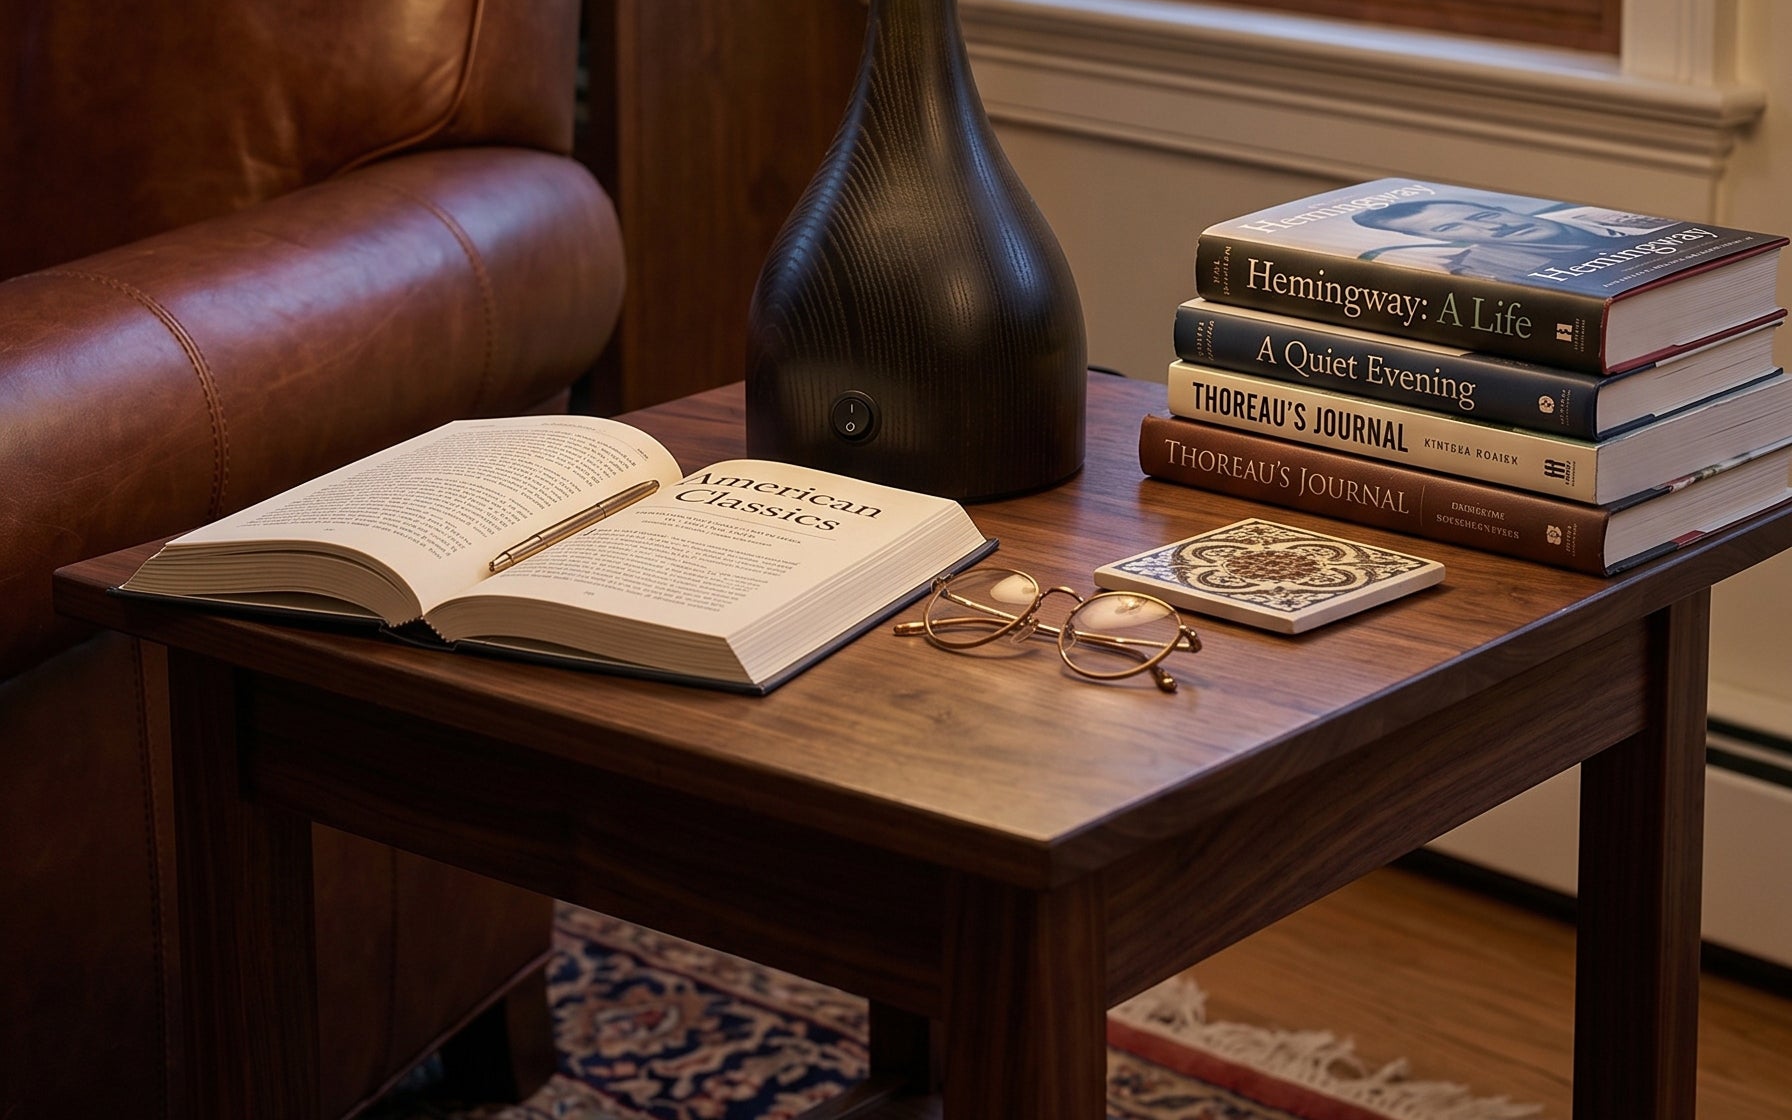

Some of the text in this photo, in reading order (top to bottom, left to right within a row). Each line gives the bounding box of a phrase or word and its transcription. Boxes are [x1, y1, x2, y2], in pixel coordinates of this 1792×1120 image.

[1242, 183, 1436, 234] Hemingway
[1527, 227, 1719, 283] Hemingway
[1246, 257, 1429, 327] Hemingway:
[1435, 292, 1463, 327] A
[1470, 296, 1533, 340] Life
[1255, 335, 1278, 365] A
[1284, 340, 1359, 379] Quiet
[1366, 354, 1477, 411] Evening
[1192, 381, 1410, 454] THOREAU'S JOURNAL
[676, 471, 883, 520] American
[1164, 438, 1410, 515] THOREAU'S JOURNAL
[674, 488, 841, 532] Classics
